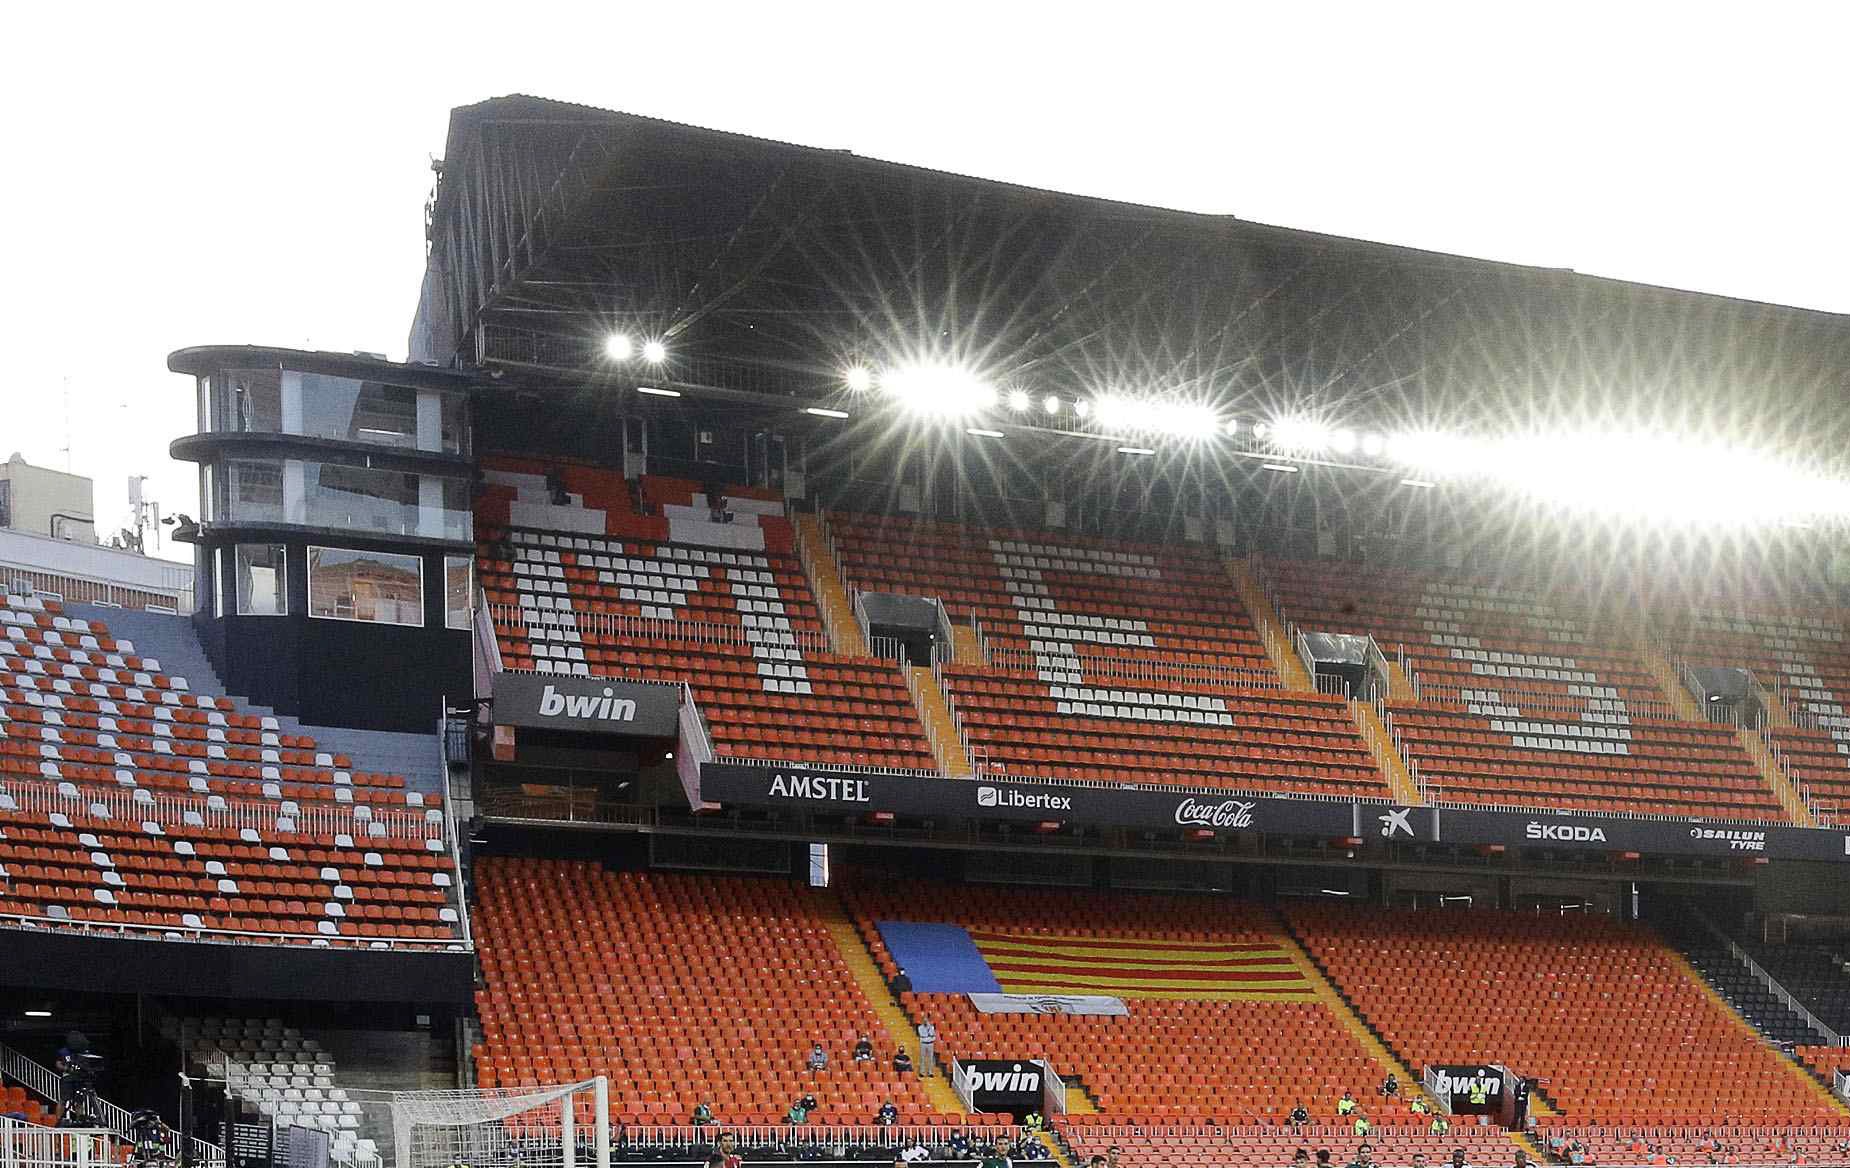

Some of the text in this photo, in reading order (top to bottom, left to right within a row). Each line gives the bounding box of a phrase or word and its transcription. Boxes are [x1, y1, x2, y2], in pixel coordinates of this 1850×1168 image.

[539, 685, 638, 721] bwin
[769, 774, 870, 802] AMSTEL
[998, 789, 1071, 810] Libertex
[1175, 798, 1256, 828] Coca-Cola
[1526, 822, 1607, 843] ŠKODA
[1703, 829, 1765, 841] SAILUN
[1730, 841, 1764, 851] TYRE
[966, 1064, 1041, 1093] bwin
[1435, 1069, 1501, 1095] bwin
